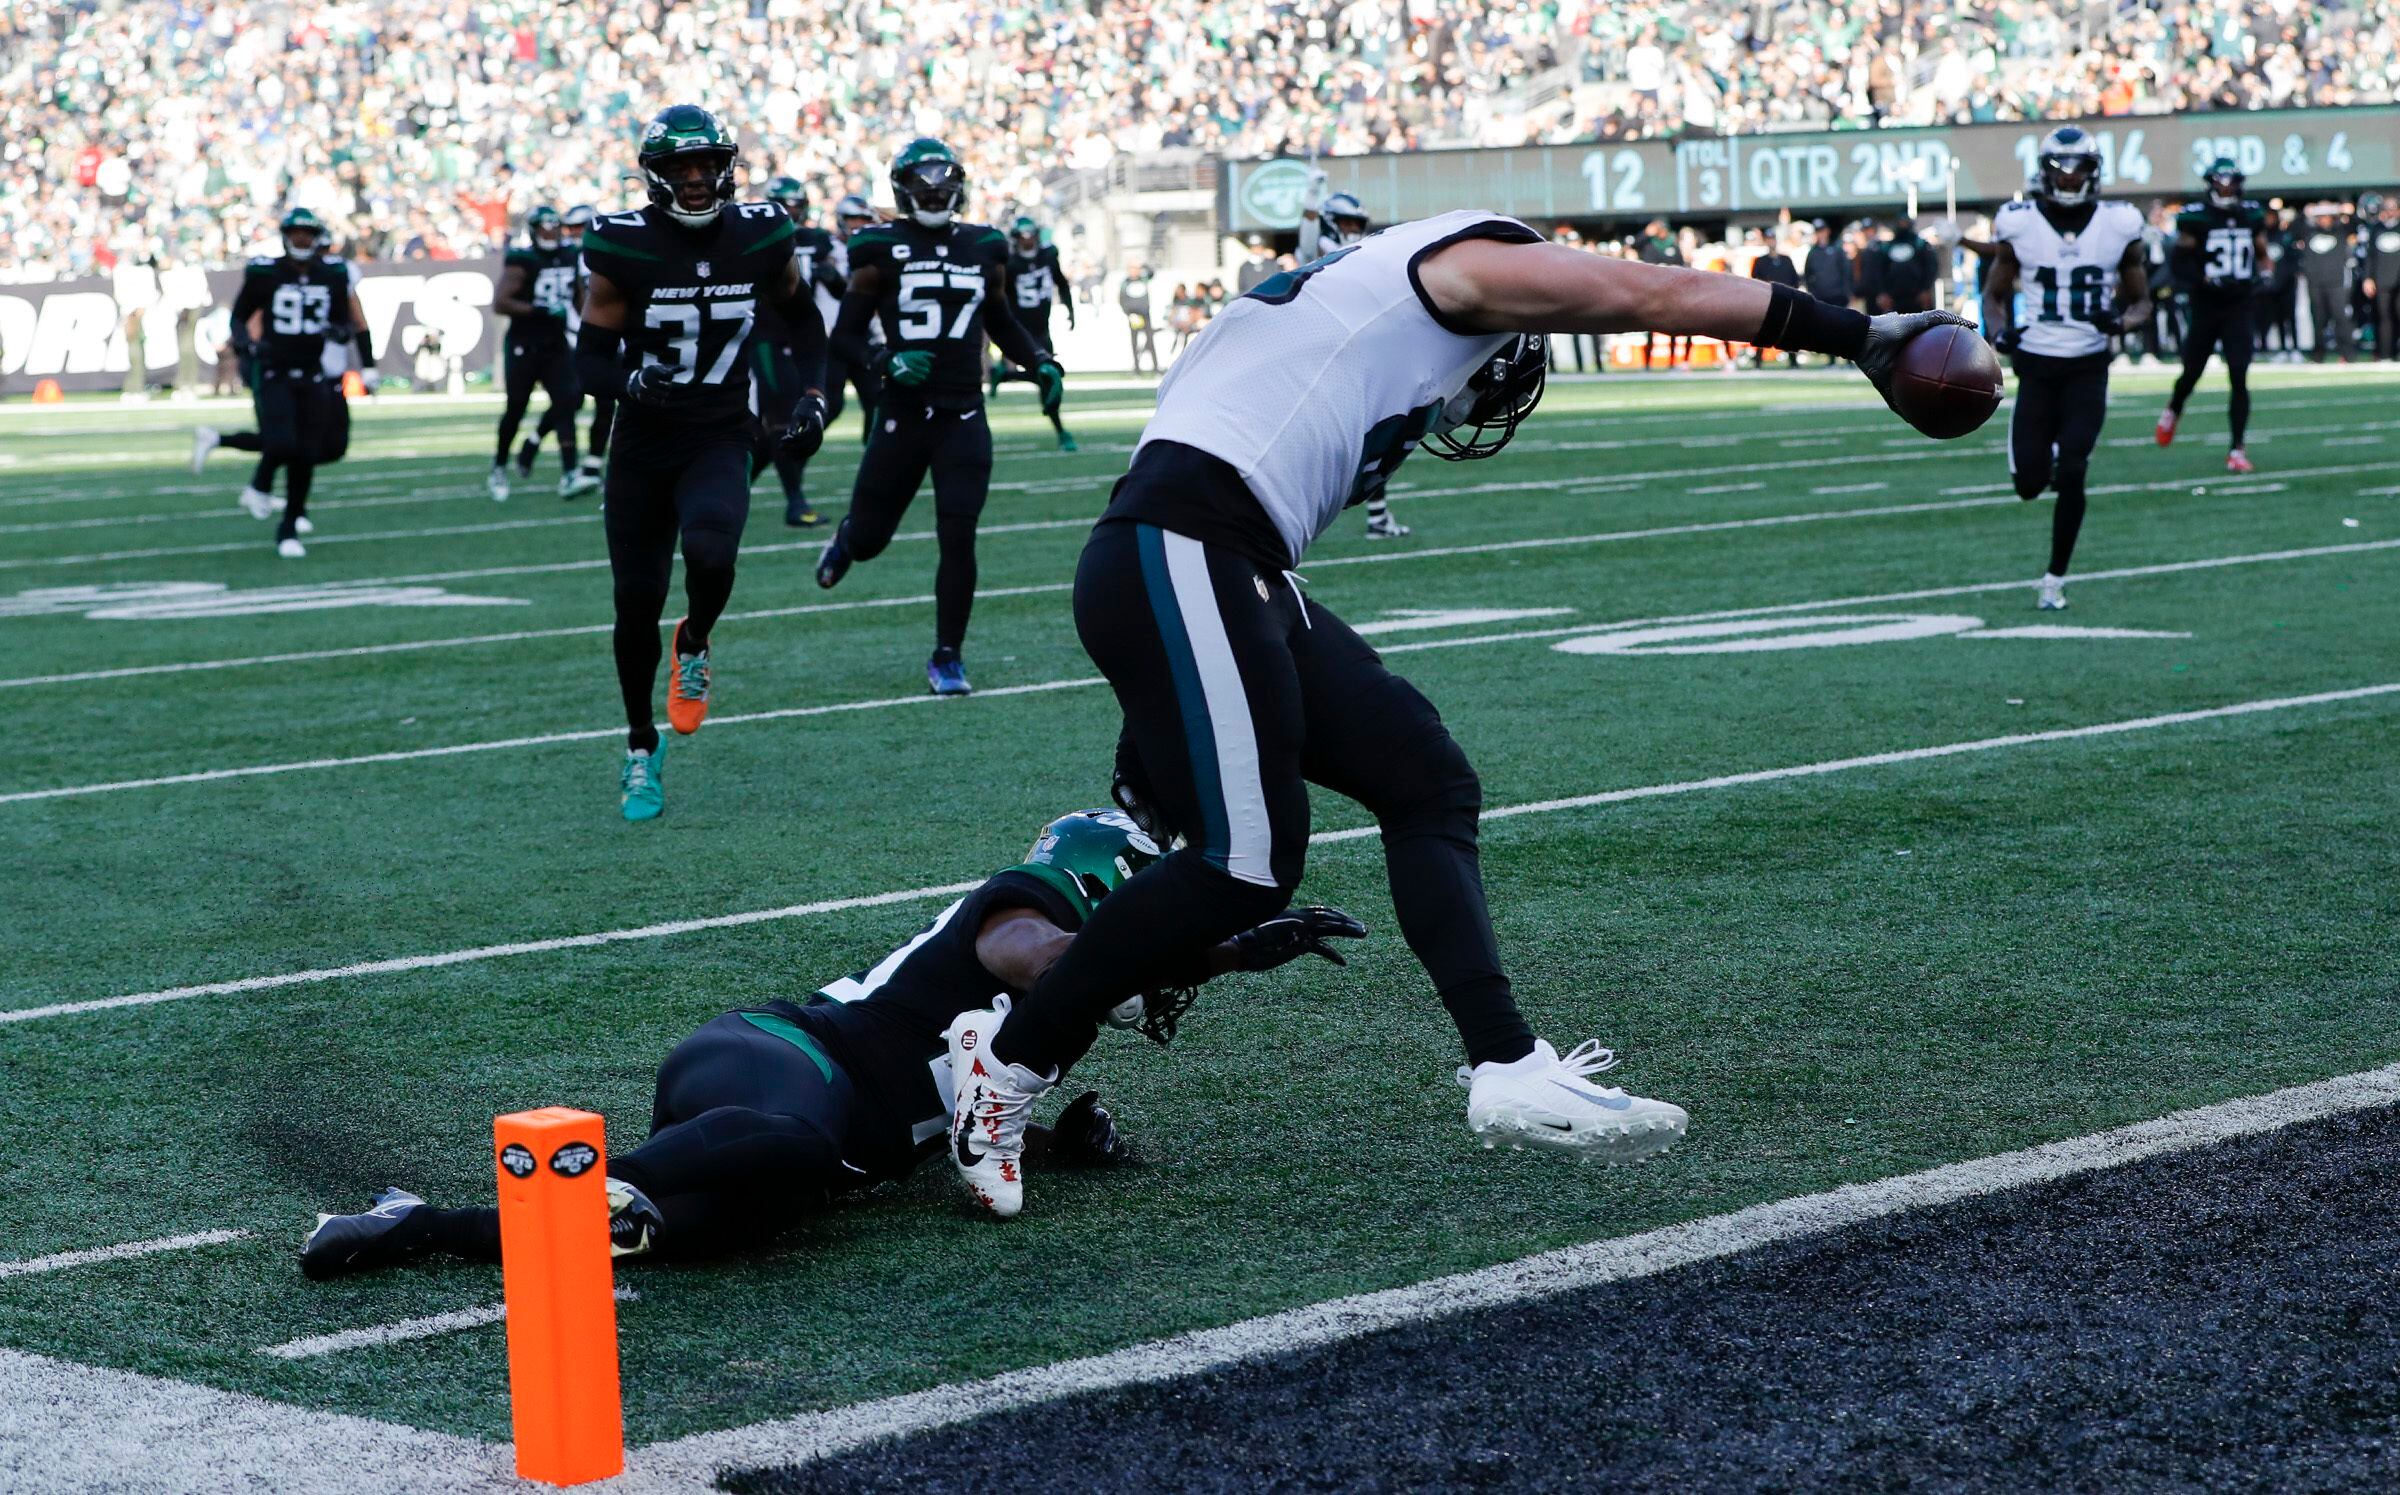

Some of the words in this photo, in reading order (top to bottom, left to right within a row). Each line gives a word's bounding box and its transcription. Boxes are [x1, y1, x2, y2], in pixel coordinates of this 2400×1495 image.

[1750, 145, 1840, 199] QTR
[1850, 140, 1951, 195] 2ND
[2282, 134, 2309, 175] &
[2326, 131, 2353, 173] 4
[1582, 151, 1645, 211] 12
[1699, 168, 1722, 206] 3
[2204, 237, 2255, 279] 30
[272, 290, 331, 335] 93
[651, 287, 700, 299] NEW
[703, 283, 754, 298] YORK
[898, 272, 985, 340] 57
[2034, 265, 2103, 322] 16
[642, 299, 756, 385] 37
